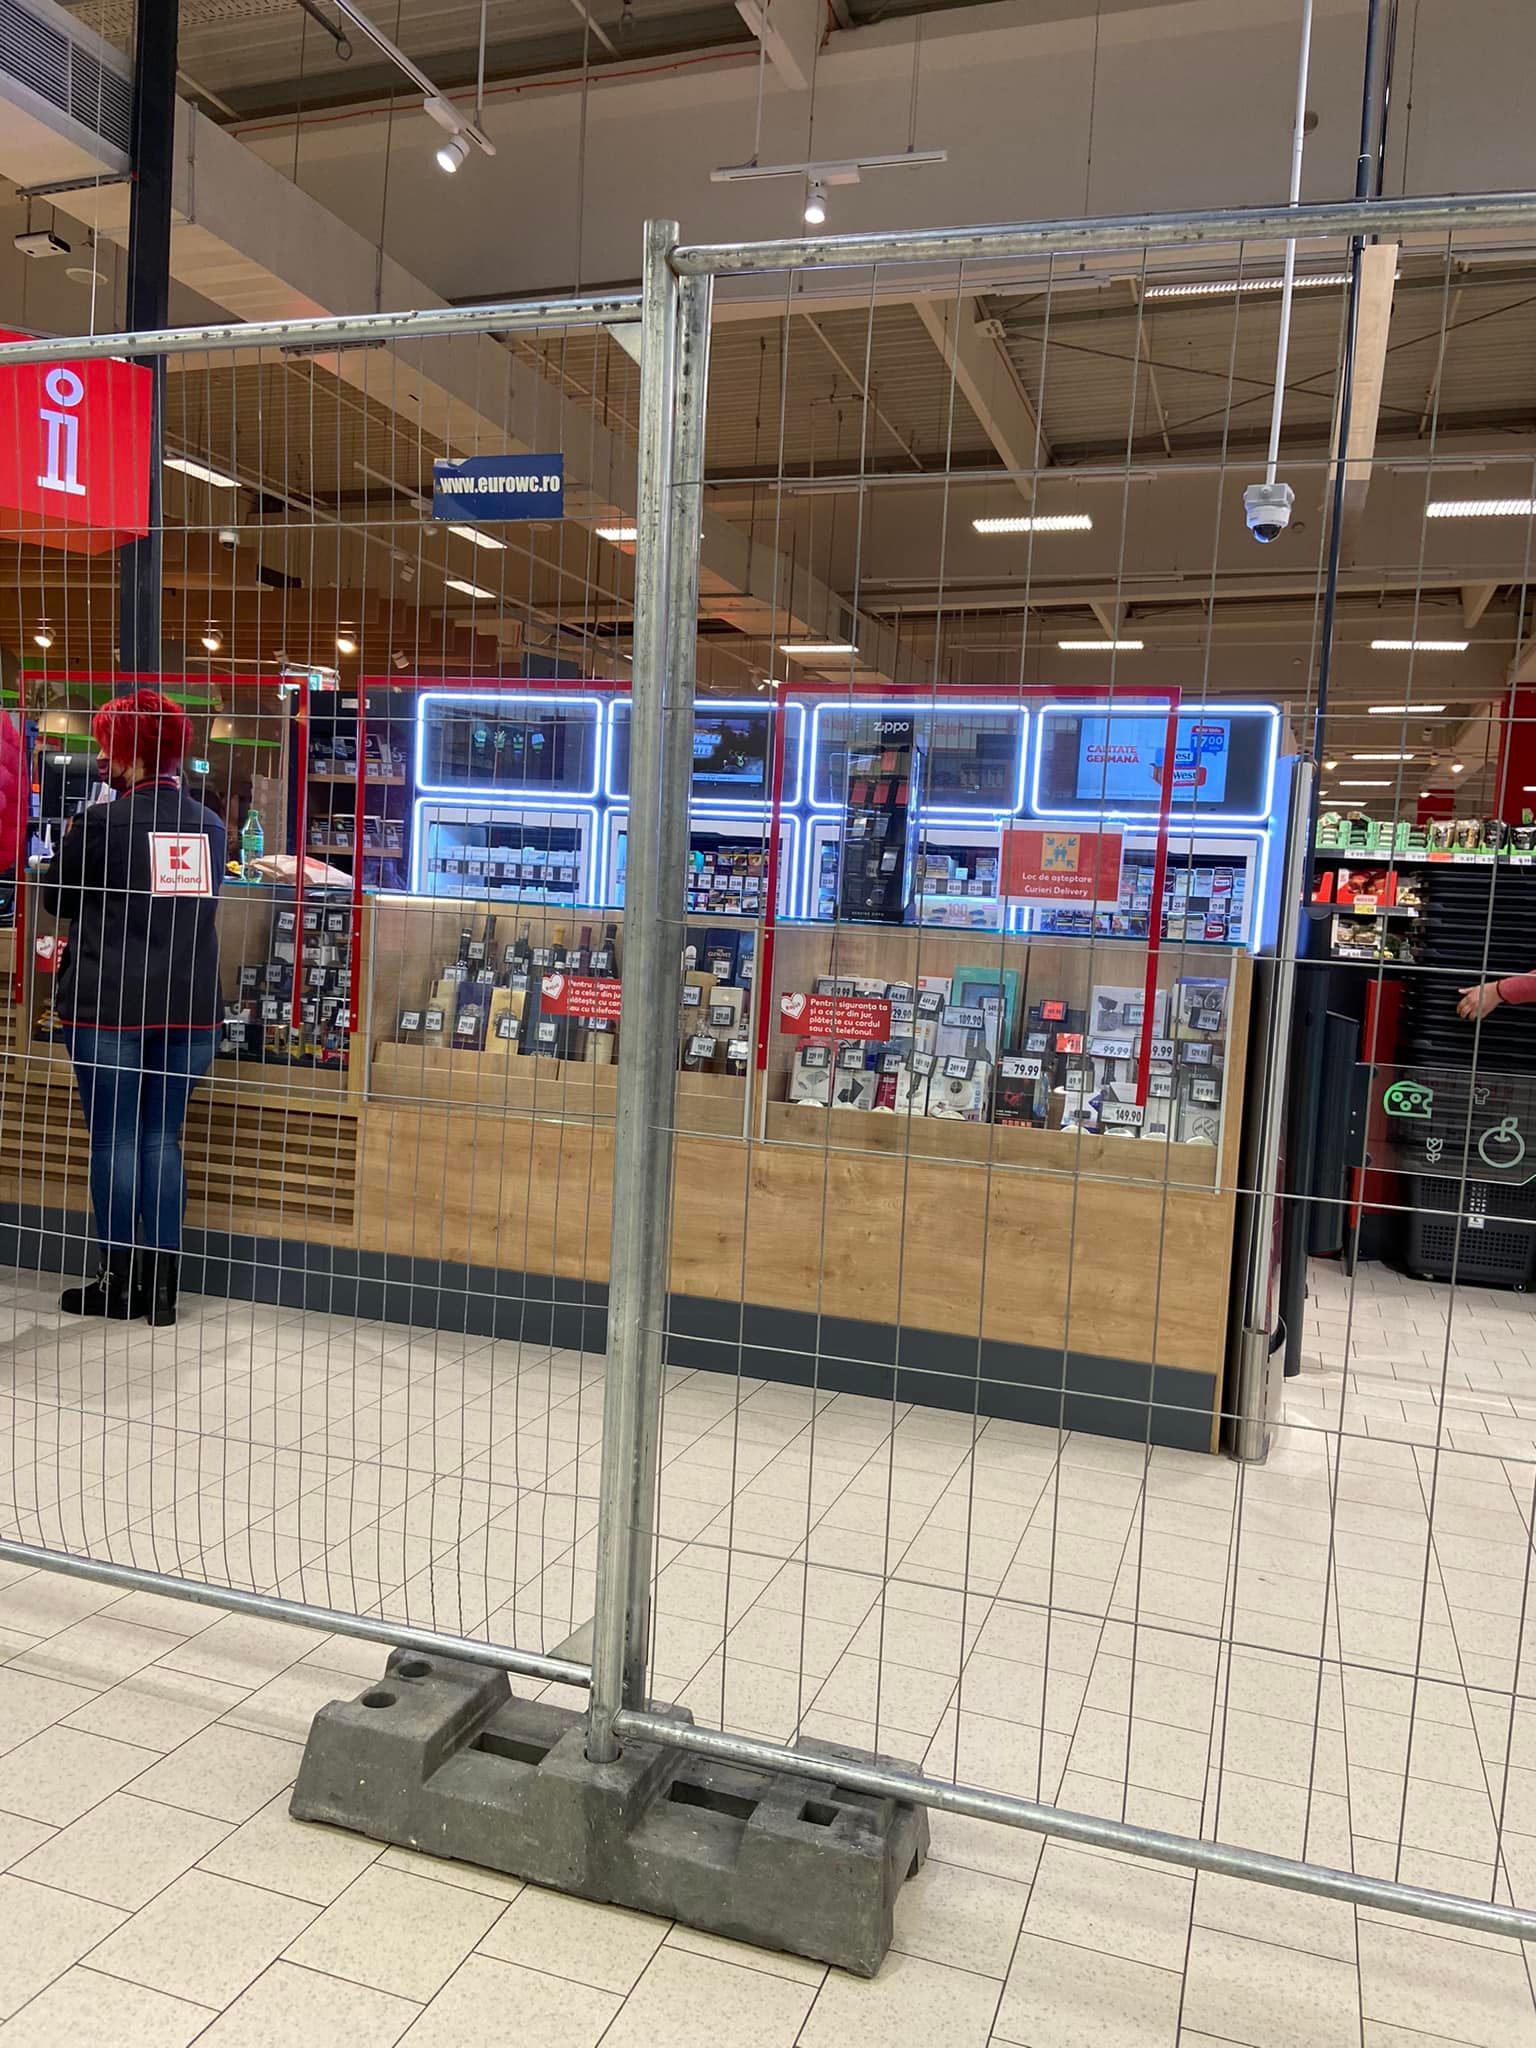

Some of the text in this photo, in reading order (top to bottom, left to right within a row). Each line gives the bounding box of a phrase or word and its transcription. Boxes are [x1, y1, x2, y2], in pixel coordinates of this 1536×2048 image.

[439, 475, 561, 494] www.eurowc.ro
[1175, 752, 1192, 762] est
[1022, 872, 1036, 881] Loc
[1038, 873, 1050, 882] de
[1024, 884, 1089, 897] Curieri Delivery
[601, 990, 612, 998] din
[878, 1003, 888, 1011] ta
[846, 1009, 860, 1018] din
[860, 1011, 874, 1020] jur,
[854, 1019, 881, 1028] cardul
[808, 1025, 823, 1033] sau
[1103, 1045, 1129, 1055] 99.99
[1013, 1064, 1040, 1076] 79.99
[1115, 1109, 1142, 1122] 149.90
